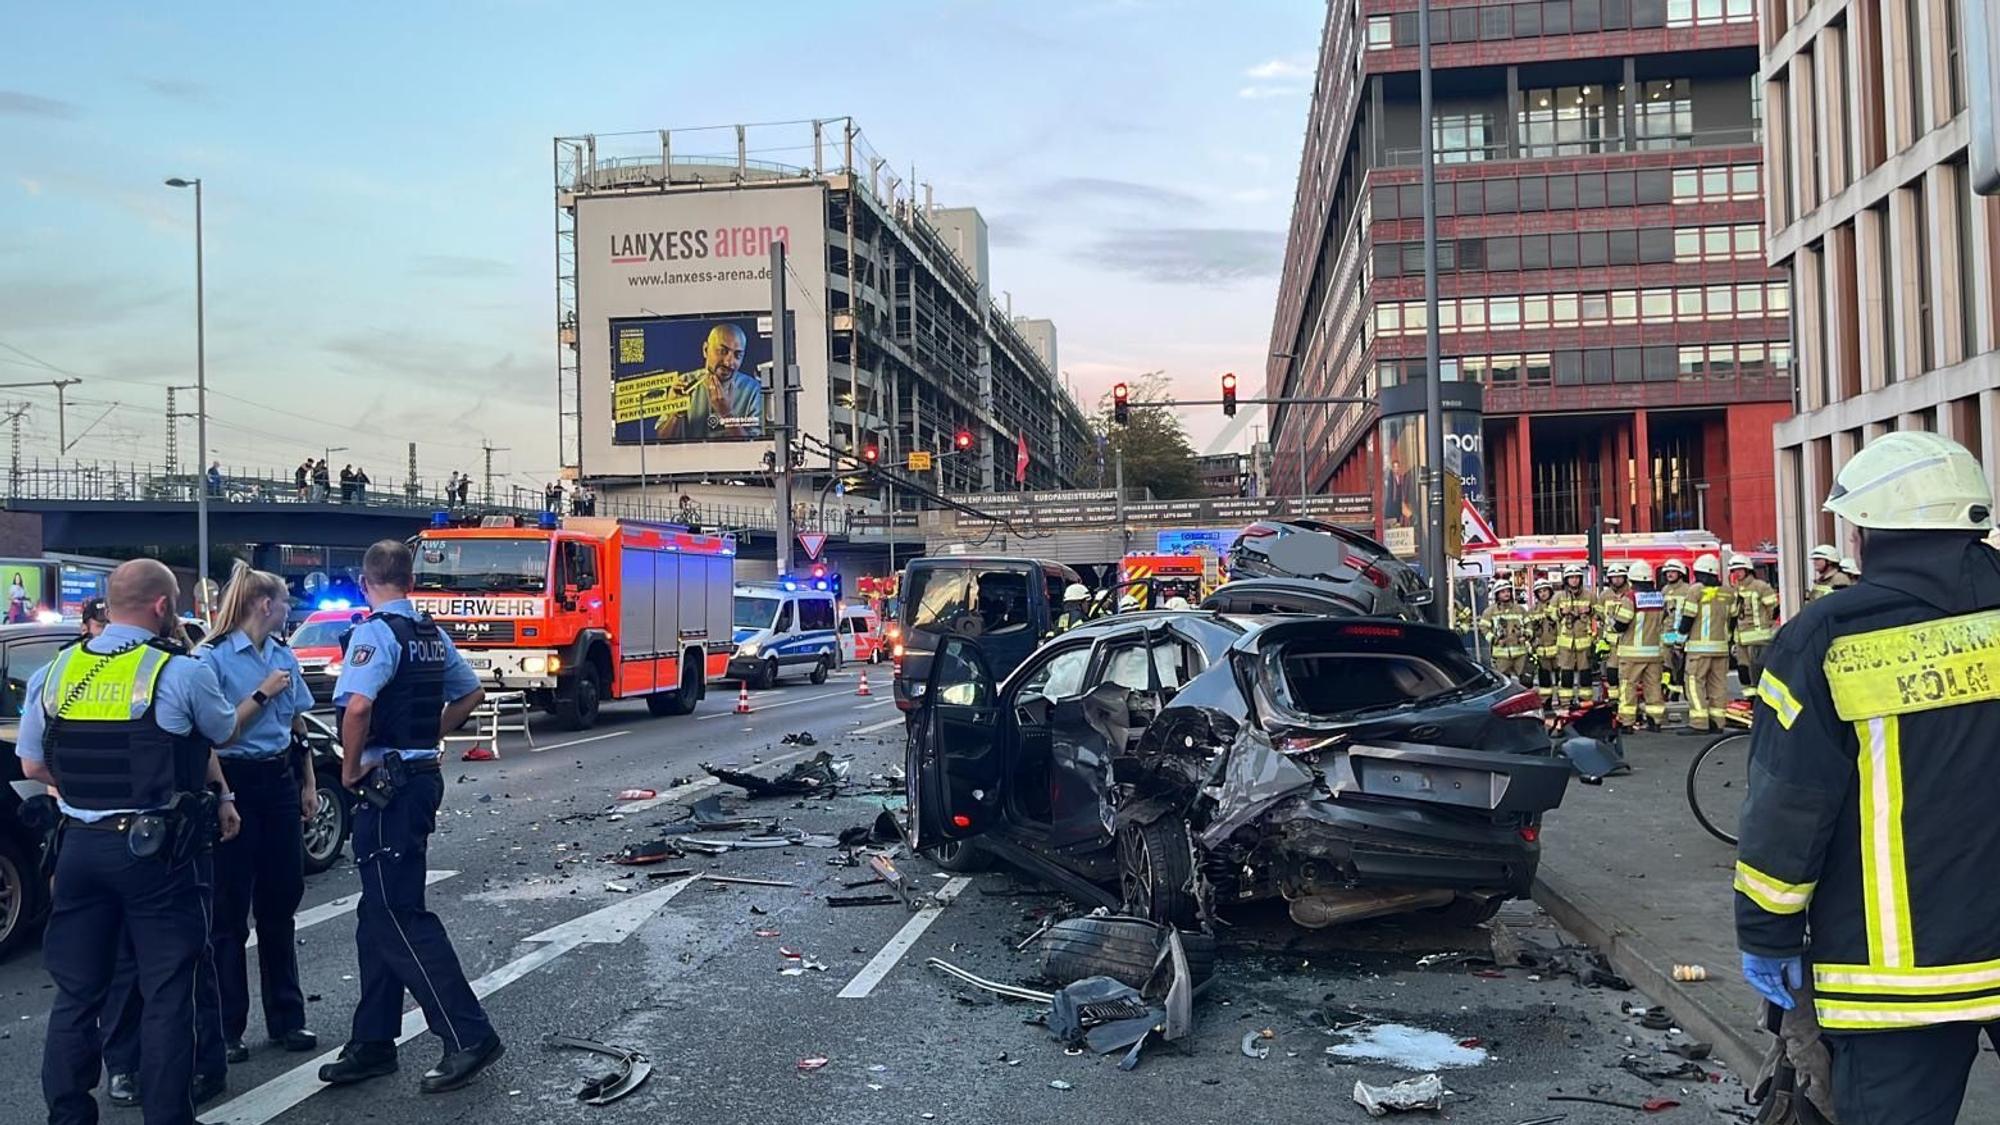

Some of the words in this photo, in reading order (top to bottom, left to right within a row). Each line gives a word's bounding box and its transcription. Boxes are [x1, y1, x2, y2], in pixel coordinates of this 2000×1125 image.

[611, 229, 709, 262] LANXESS
[714, 225, 791, 258] arena
[628, 267, 773, 287] www.lanxess-arena.de
[983, 495, 1019, 503] HANDBALL
[1034, 491, 1118, 501] EUROPAMEISTERSCHAFT
[421, 541, 447, 550] RW5
[416, 599, 534, 616] FEUERWEHR
[455, 623, 490, 631] MAN
[1896, 662, 1991, 705] KÖLN
